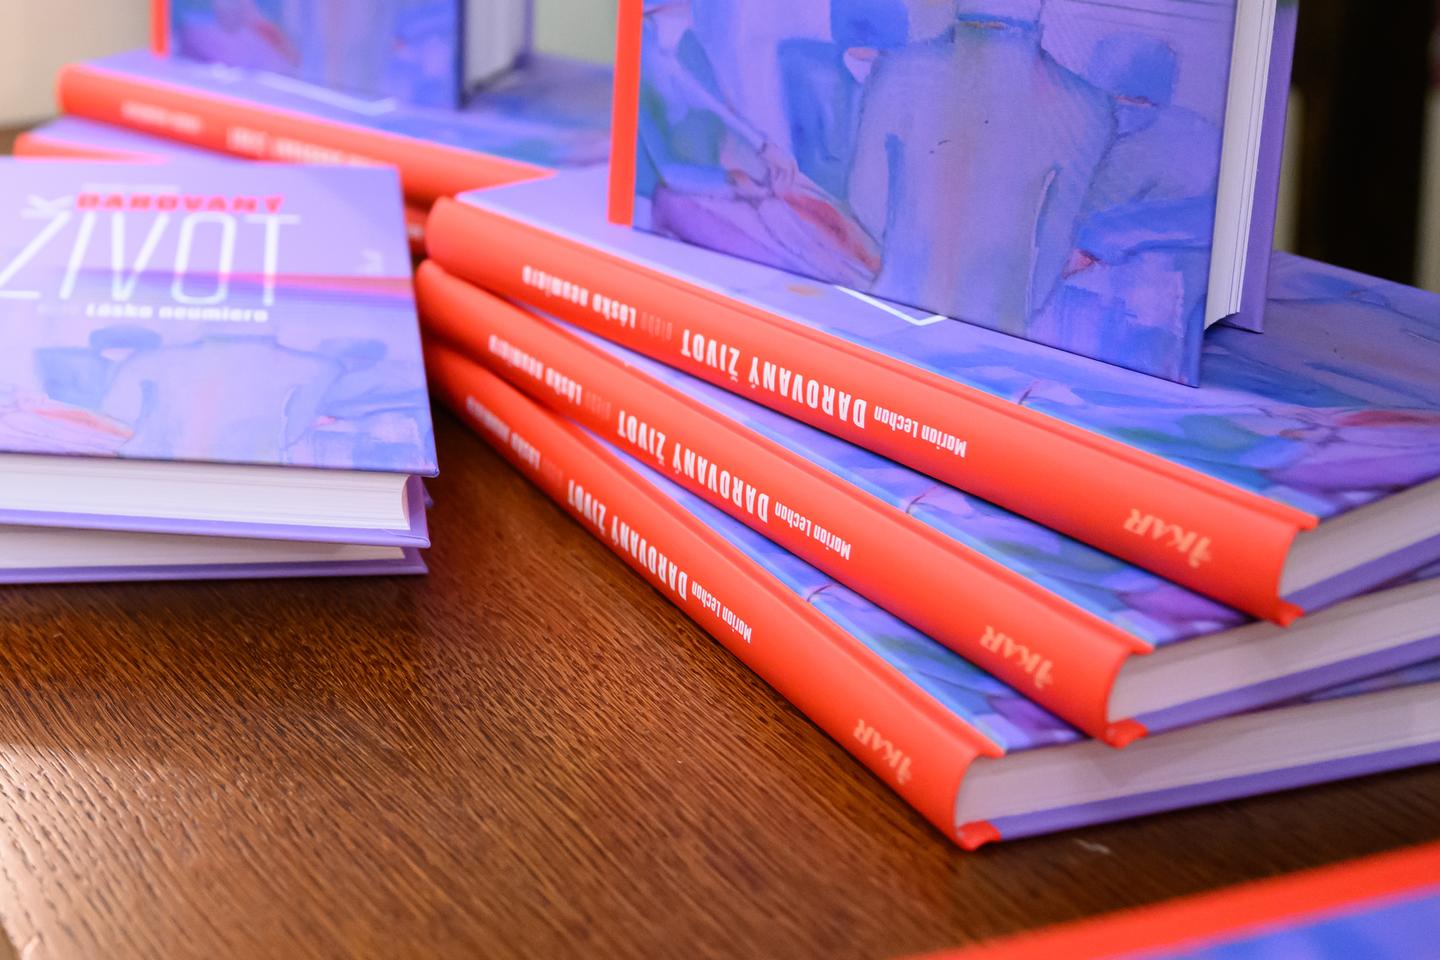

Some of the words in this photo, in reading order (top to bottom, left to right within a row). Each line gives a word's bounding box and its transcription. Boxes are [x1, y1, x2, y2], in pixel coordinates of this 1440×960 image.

[681, 329, 741, 384] ŽIVOT
[748, 357, 868, 429] DAROVANÝ
[617, 410, 667, 467] ŽIVOT
[874, 405, 919, 439] Lechan
[921, 423, 968, 458] Marian
[672, 442, 770, 524] DAROVANÝ
[774, 501, 812, 537] Lechan
[611, 515, 689, 601] DAROVANÝ
[813, 529, 852, 561] Marian
[691, 580, 722, 618] Lechan
[721, 607, 753, 644] Marian
